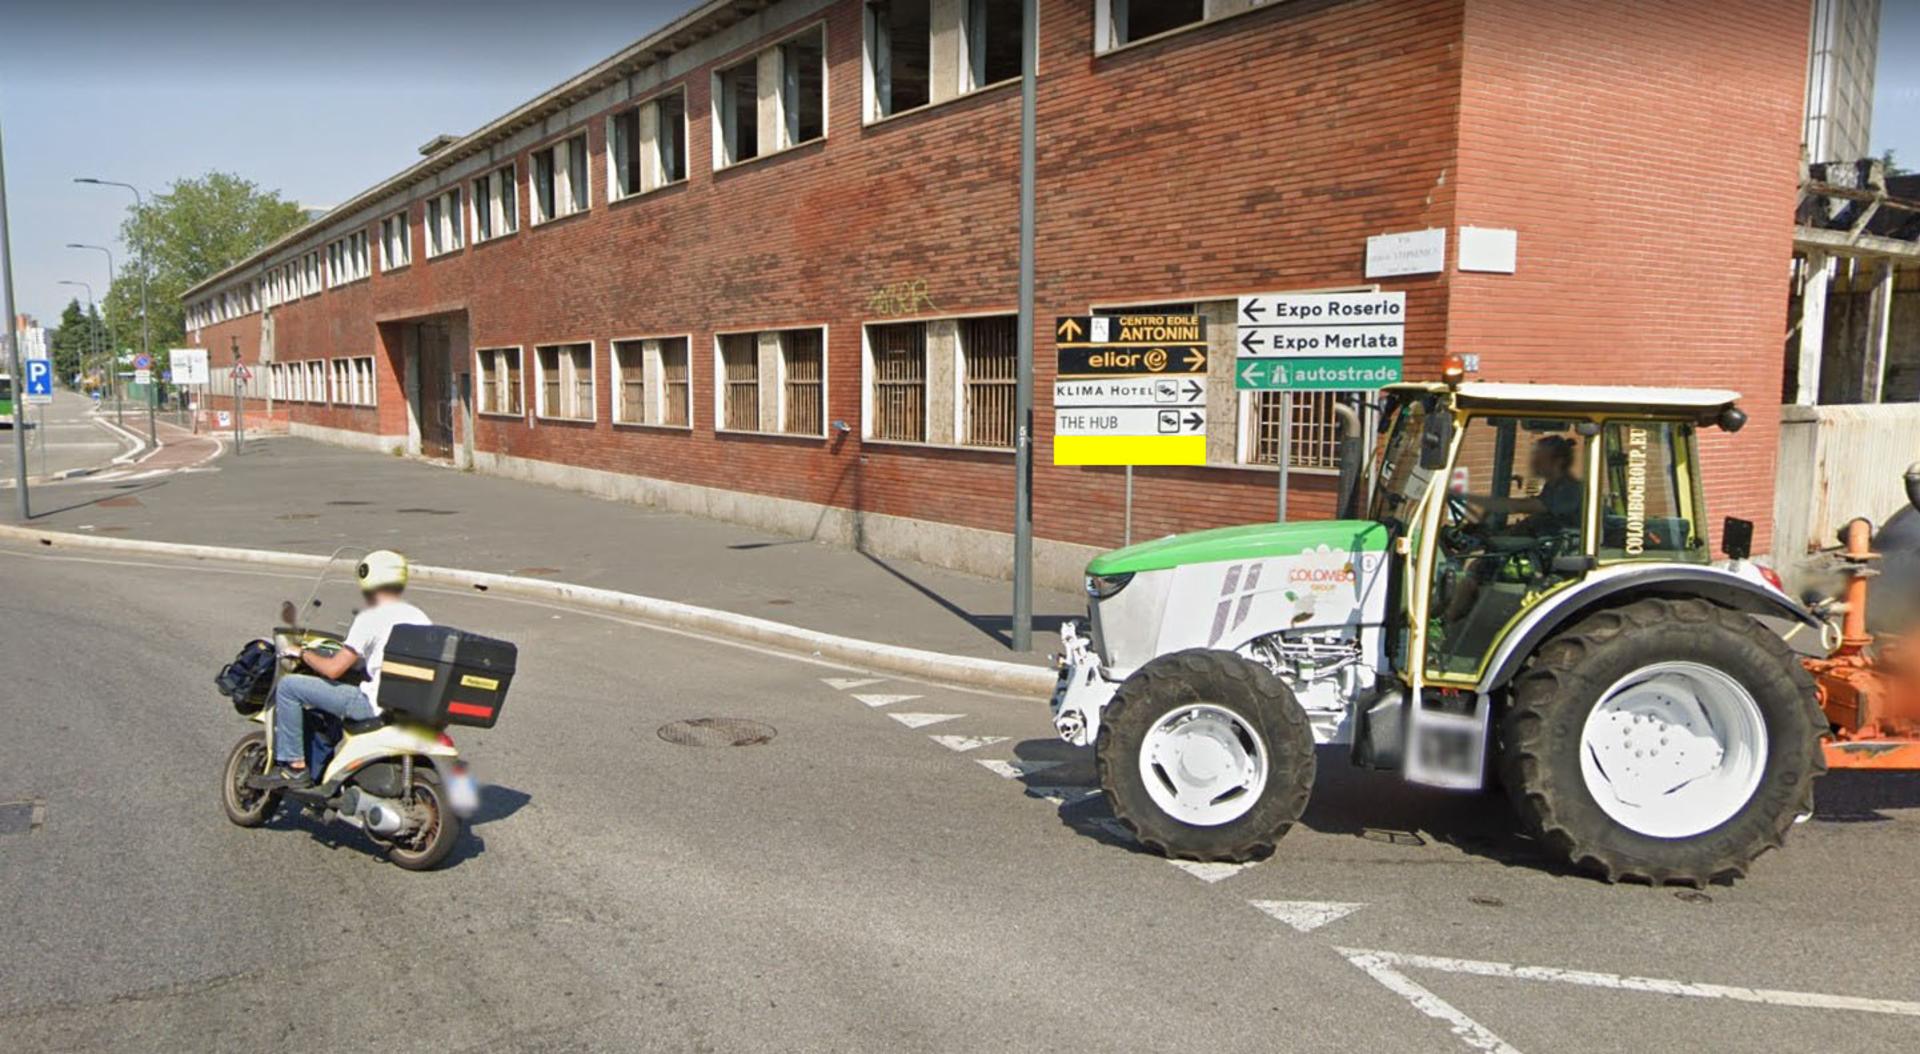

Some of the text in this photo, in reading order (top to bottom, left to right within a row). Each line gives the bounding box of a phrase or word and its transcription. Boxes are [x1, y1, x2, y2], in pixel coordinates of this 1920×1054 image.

[1276, 300, 1400, 319] Expo Roserio
[1119, 316, 1199, 326] CENTRO EDILE
[1119, 327, 1199, 340] ANTONINI
[1273, 334, 1397, 352] Expo Merlata
[1088, 351, 1140, 368] elior
[30, 362, 47, 382] P
[1295, 366, 1397, 381] autostrade
[1057, 386, 1154, 396] KLIMA HOTEL
[1060, 416, 1118, 429] THE HUB
[1626, 428, 1647, 555] COLOMBOGROUP.EU
